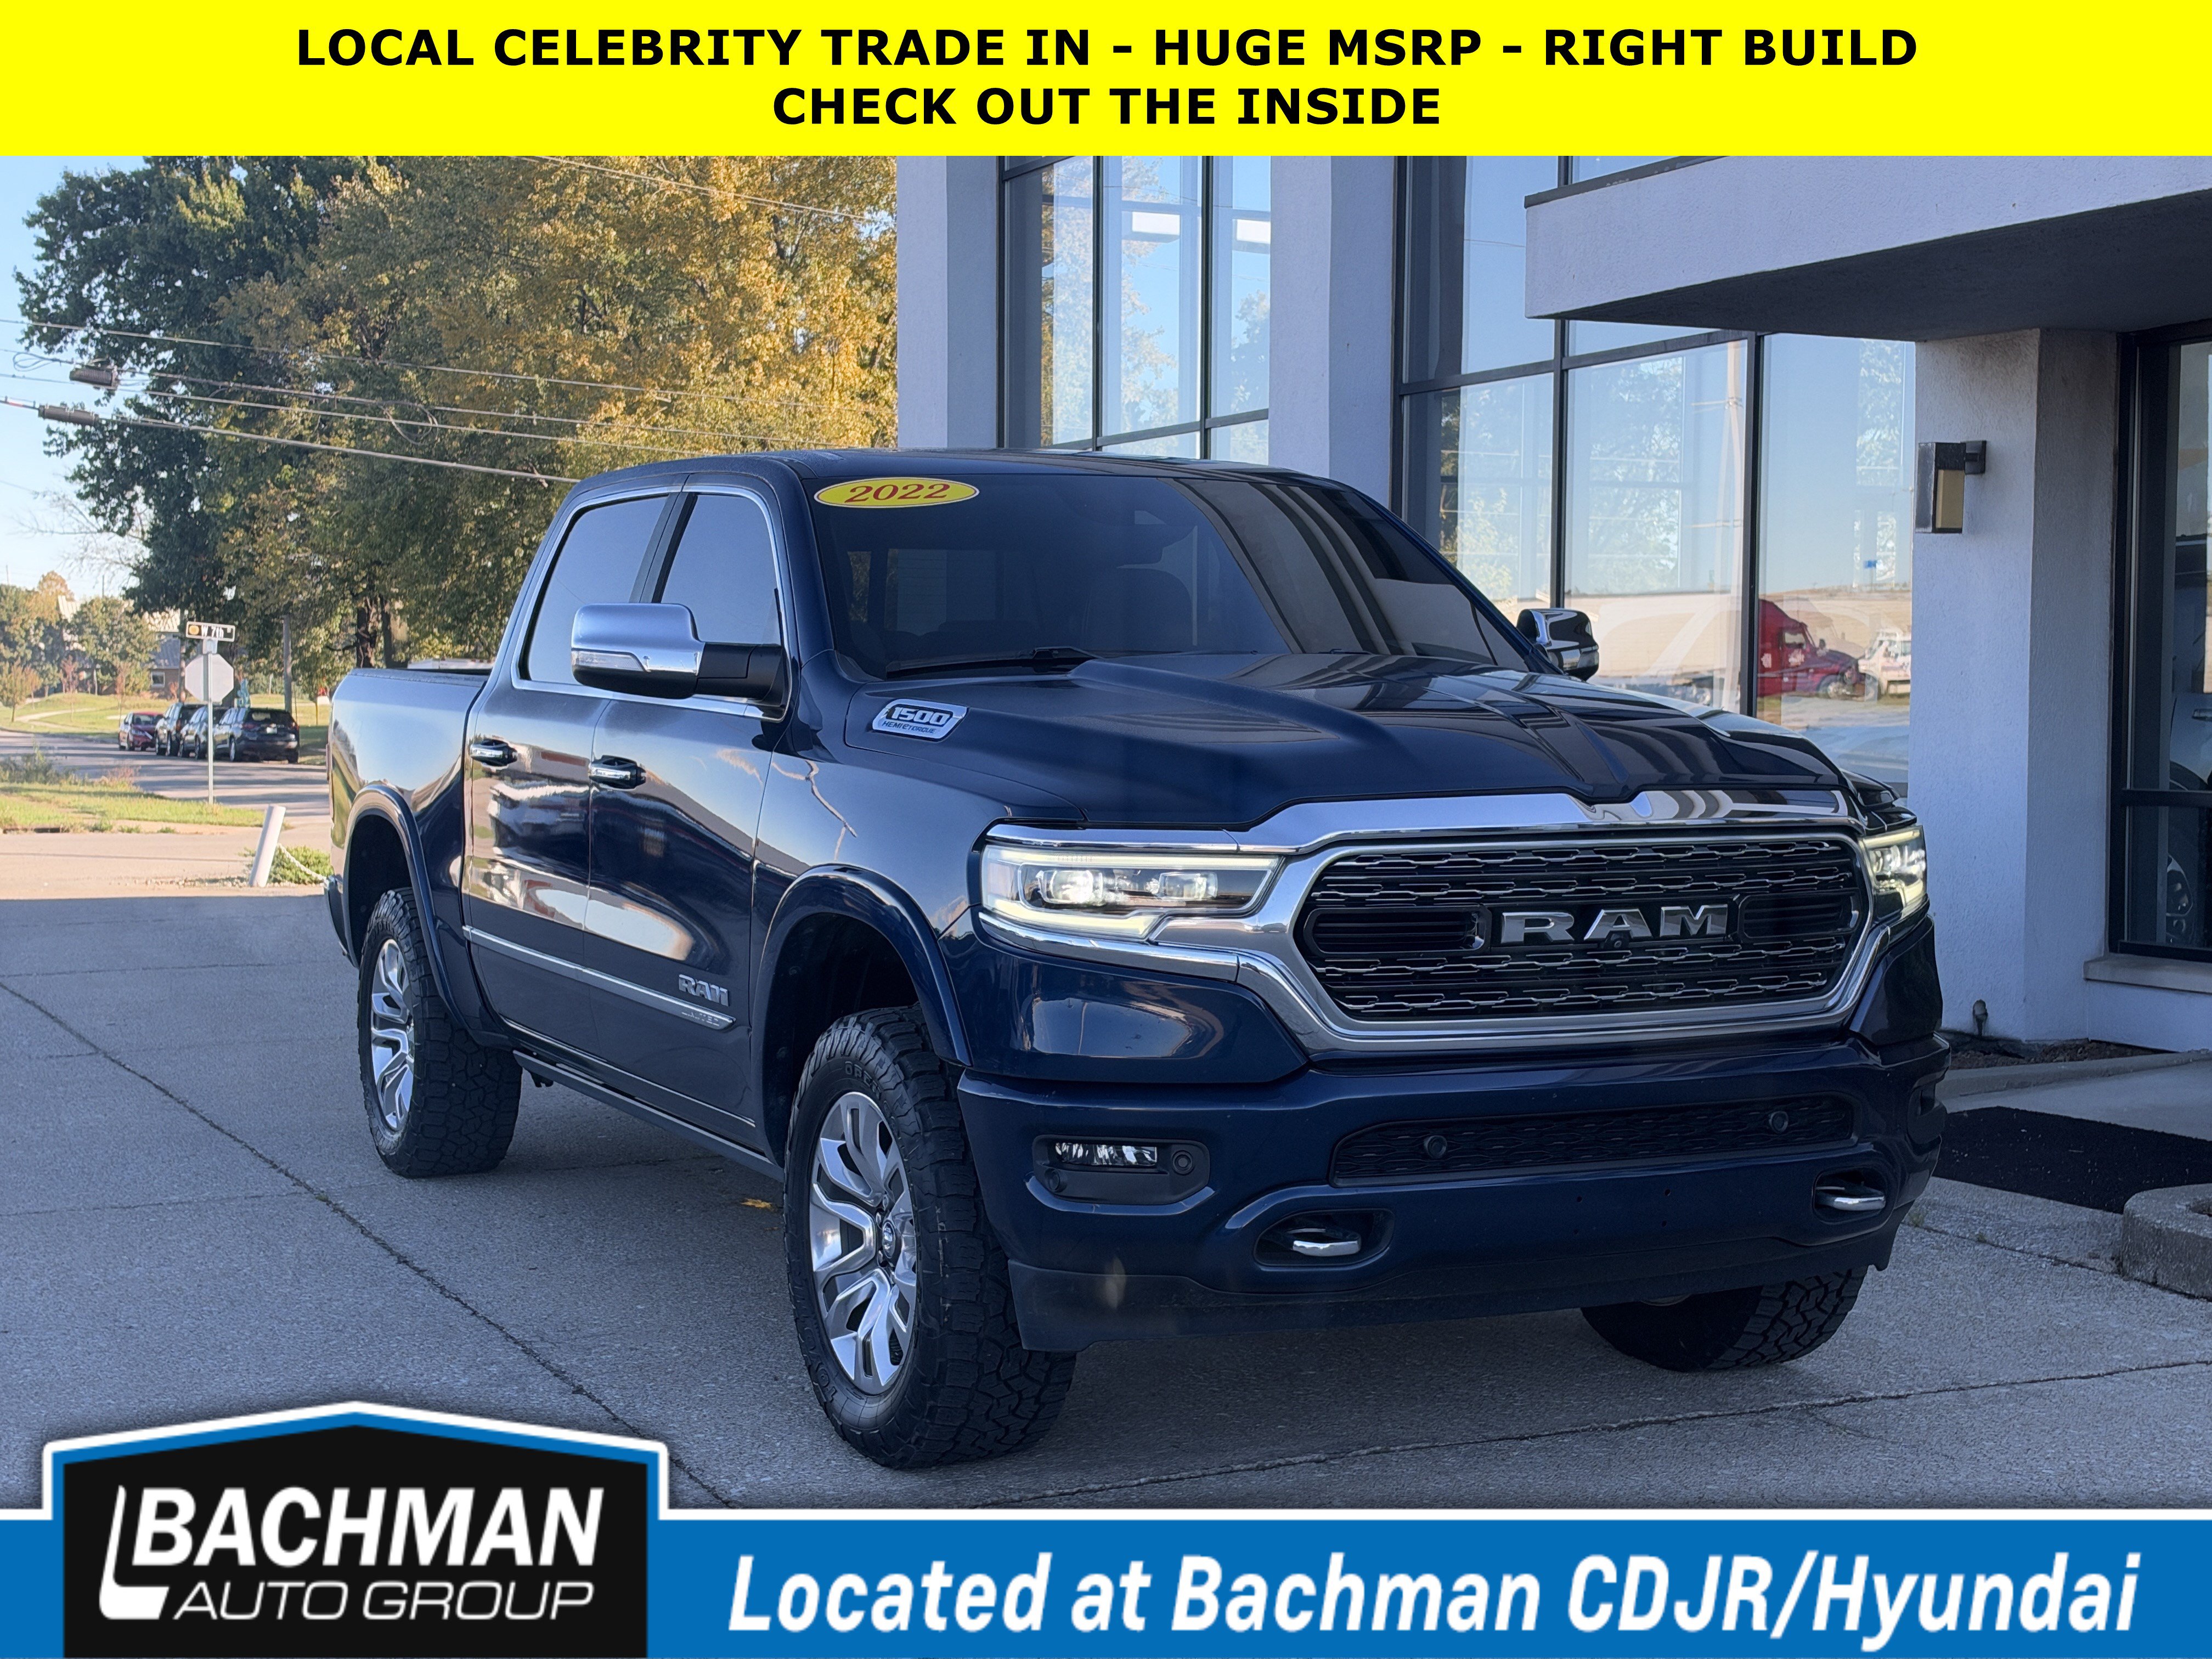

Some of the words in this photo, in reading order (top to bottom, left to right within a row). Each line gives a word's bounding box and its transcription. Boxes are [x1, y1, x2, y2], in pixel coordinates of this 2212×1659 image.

[844, 483, 950, 503] 2022
[201, 625, 208, 638] W
[211, 626, 224, 639] 7th
[891, 707, 950, 725] 1500
[1501, 904, 1728, 944] RAM
[679, 974, 729, 1007] RAM
